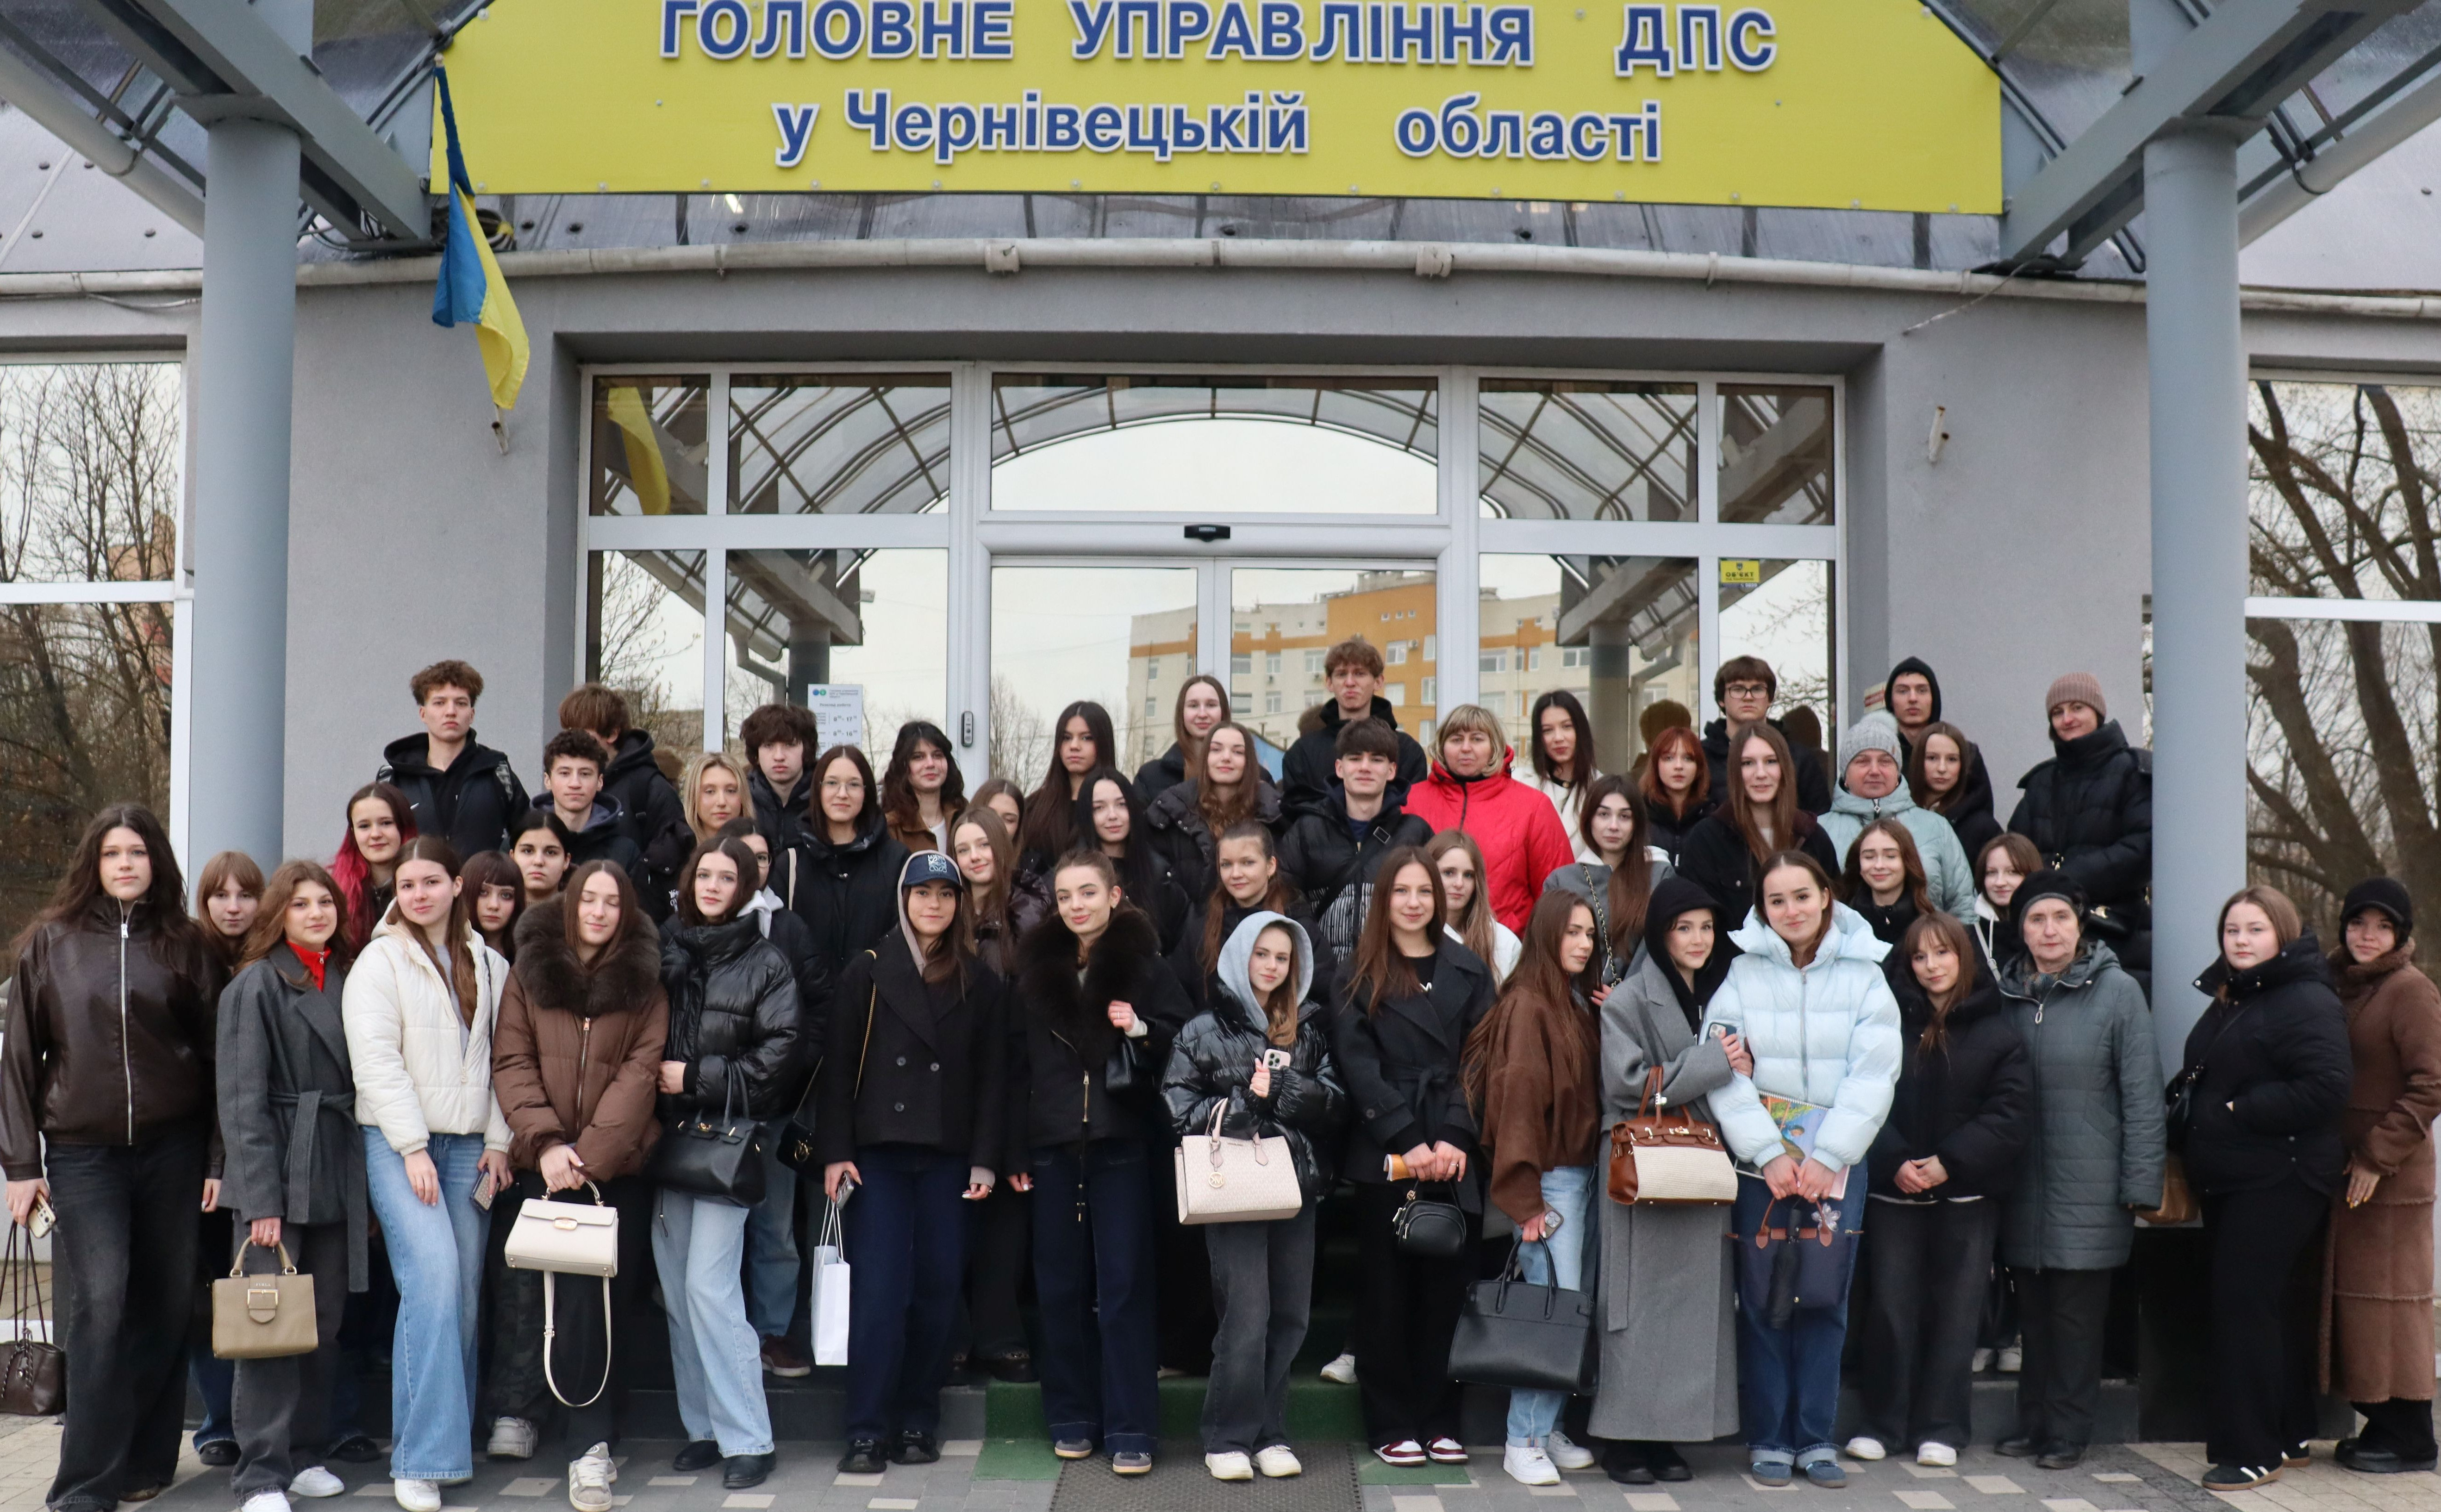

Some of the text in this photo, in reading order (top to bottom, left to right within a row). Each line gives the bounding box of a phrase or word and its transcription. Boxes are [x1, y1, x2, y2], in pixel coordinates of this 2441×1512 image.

[659, 0, 1778, 77] ГОЛОВНЕ УПРАВЛІННЯ ДПС
[771, 89, 1661, 167] у Чернівецькій області
